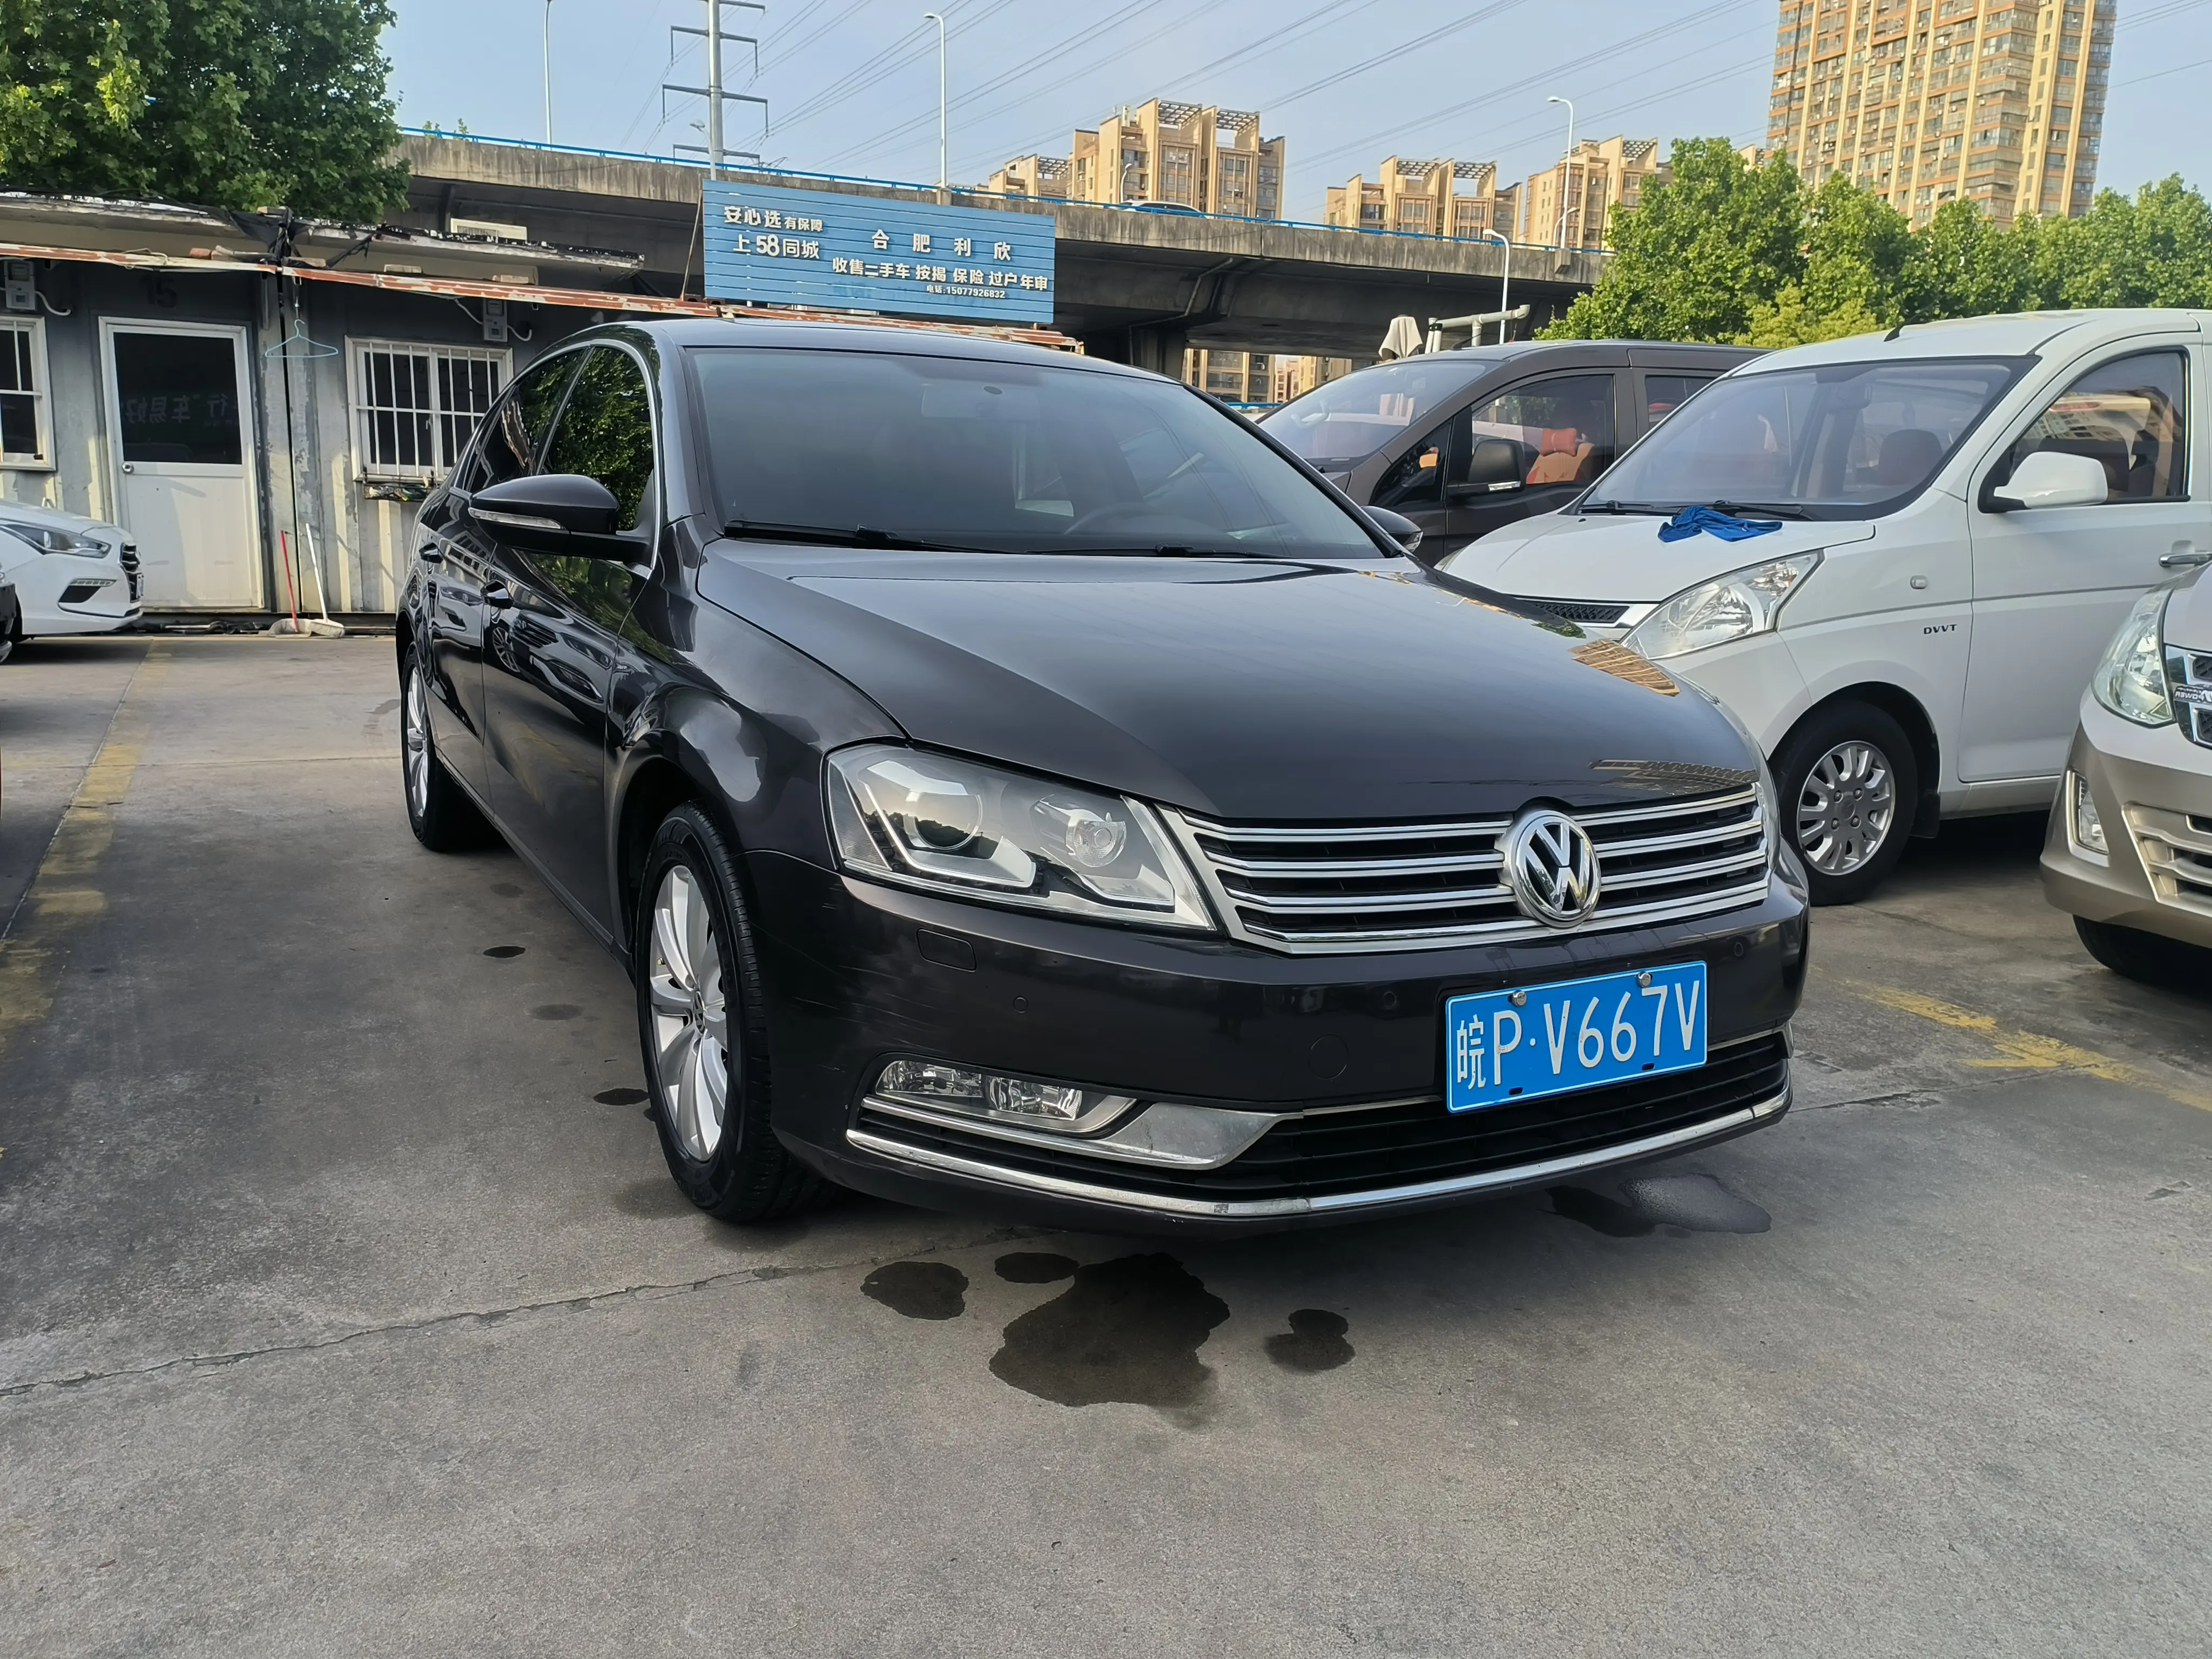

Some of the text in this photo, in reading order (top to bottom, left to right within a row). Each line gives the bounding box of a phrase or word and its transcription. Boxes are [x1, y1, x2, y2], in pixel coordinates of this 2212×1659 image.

[724, 206, 823, 232] 安心选有保障
[733, 233, 820, 260] 上58同城
[872, 228, 1012, 261] 合肥利欣
[832, 257, 1049, 292] 收售二手车 按揭 保险 过户年审
[139, 276, 178, 308] 15
[1924, 624, 1958, 635] DVVT
